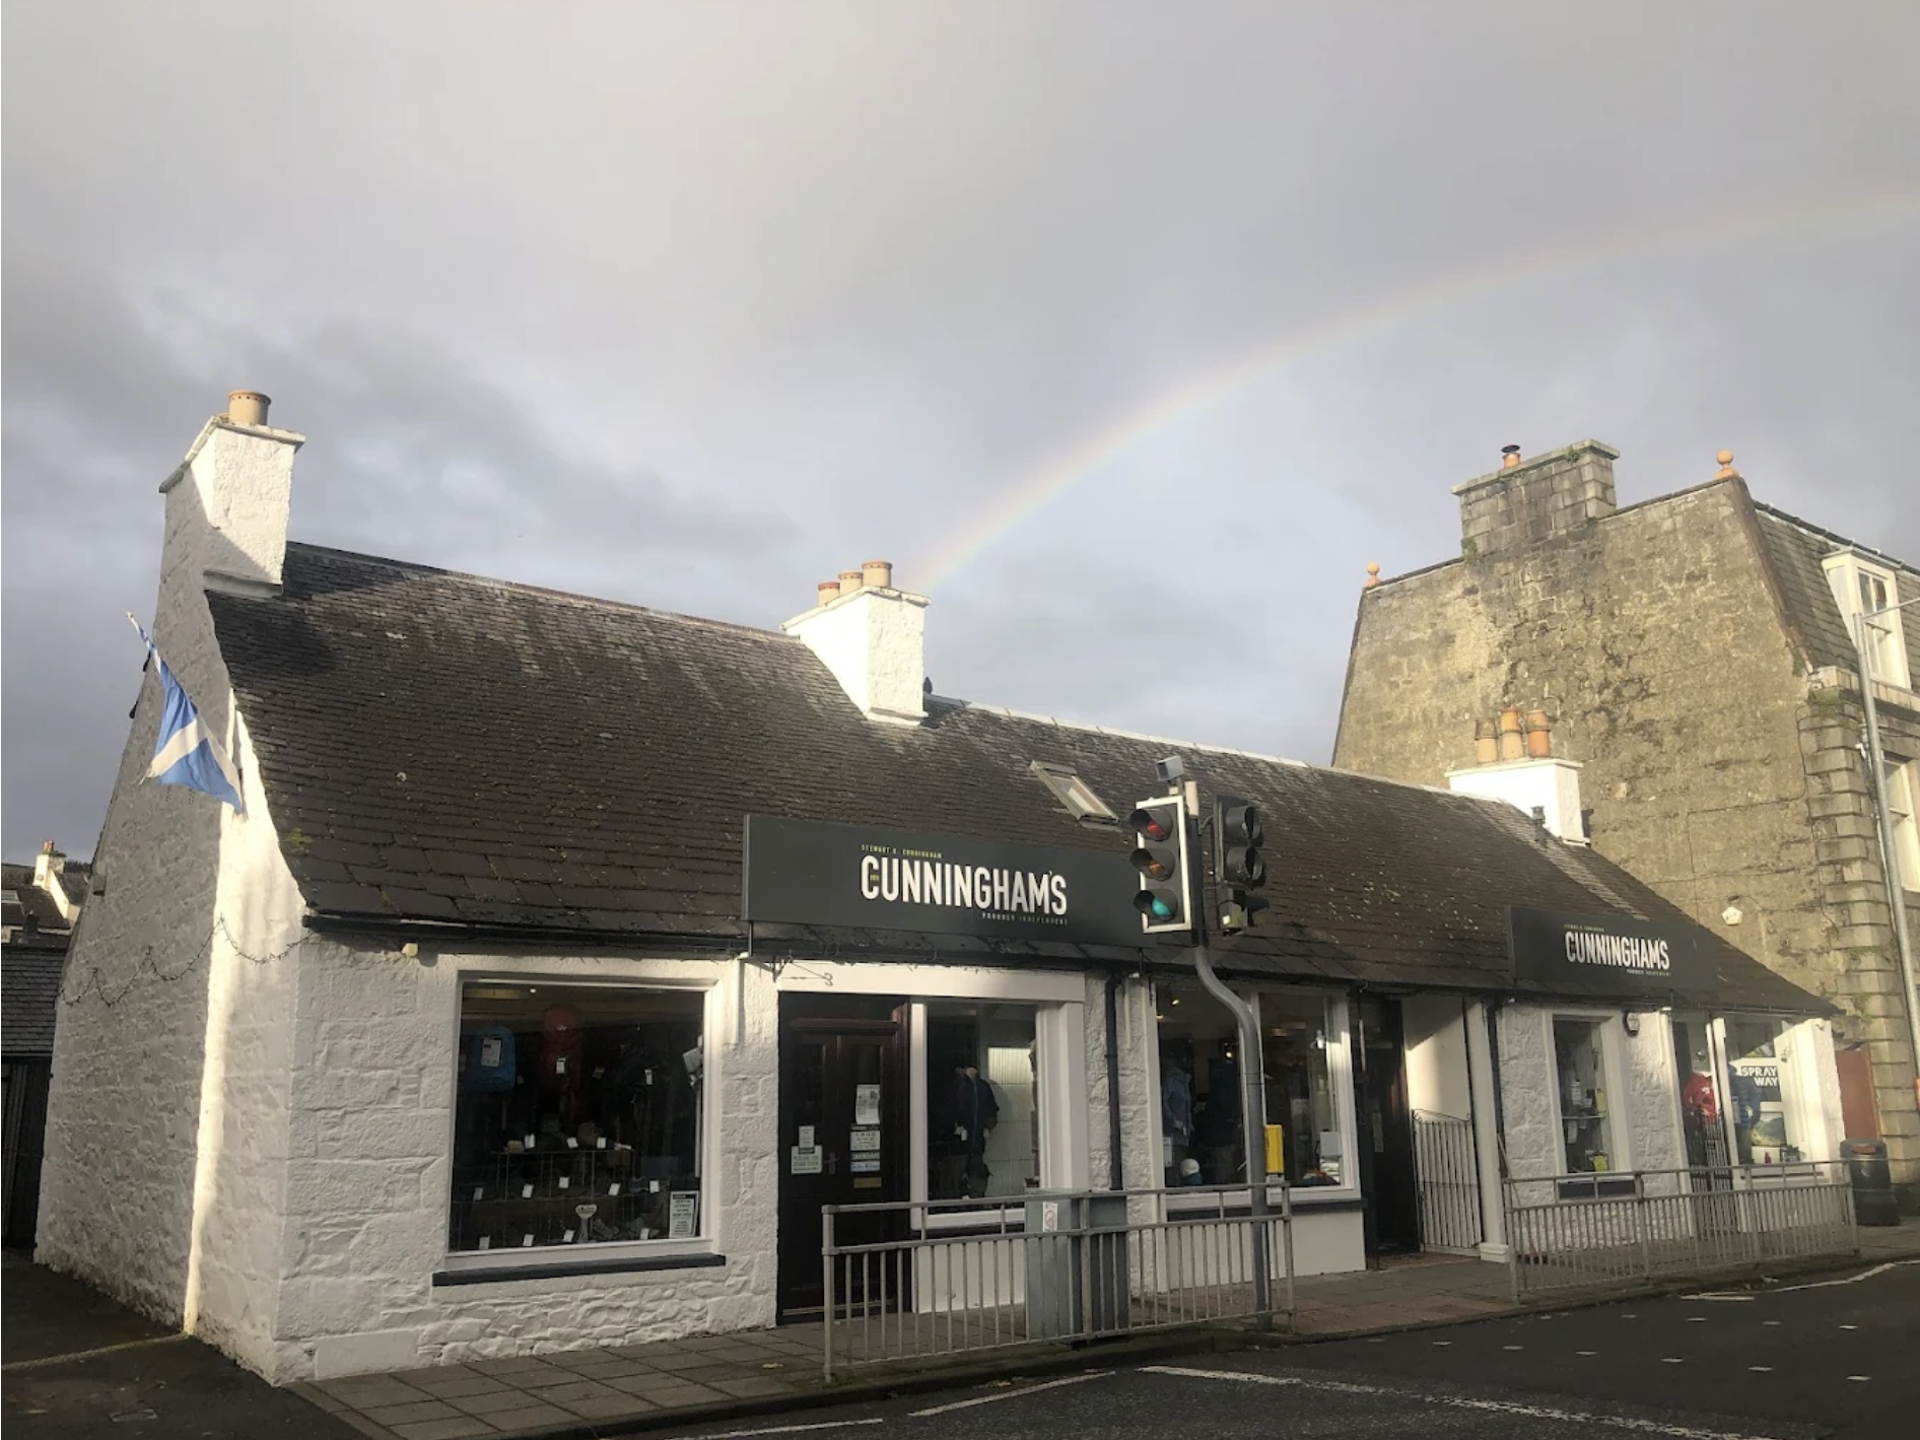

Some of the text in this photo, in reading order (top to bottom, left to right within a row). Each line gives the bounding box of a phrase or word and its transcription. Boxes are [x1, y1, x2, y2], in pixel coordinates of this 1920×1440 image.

[861, 855, 1067, 915] CUNNINGHAM'S
[982, 912, 1015, 921] PROUDLY
[1565, 931, 1670, 970] CUNNINGHAM'S
[1741, 1067, 1777, 1077] SPRAY
[1753, 1077, 1778, 1087] WAY
